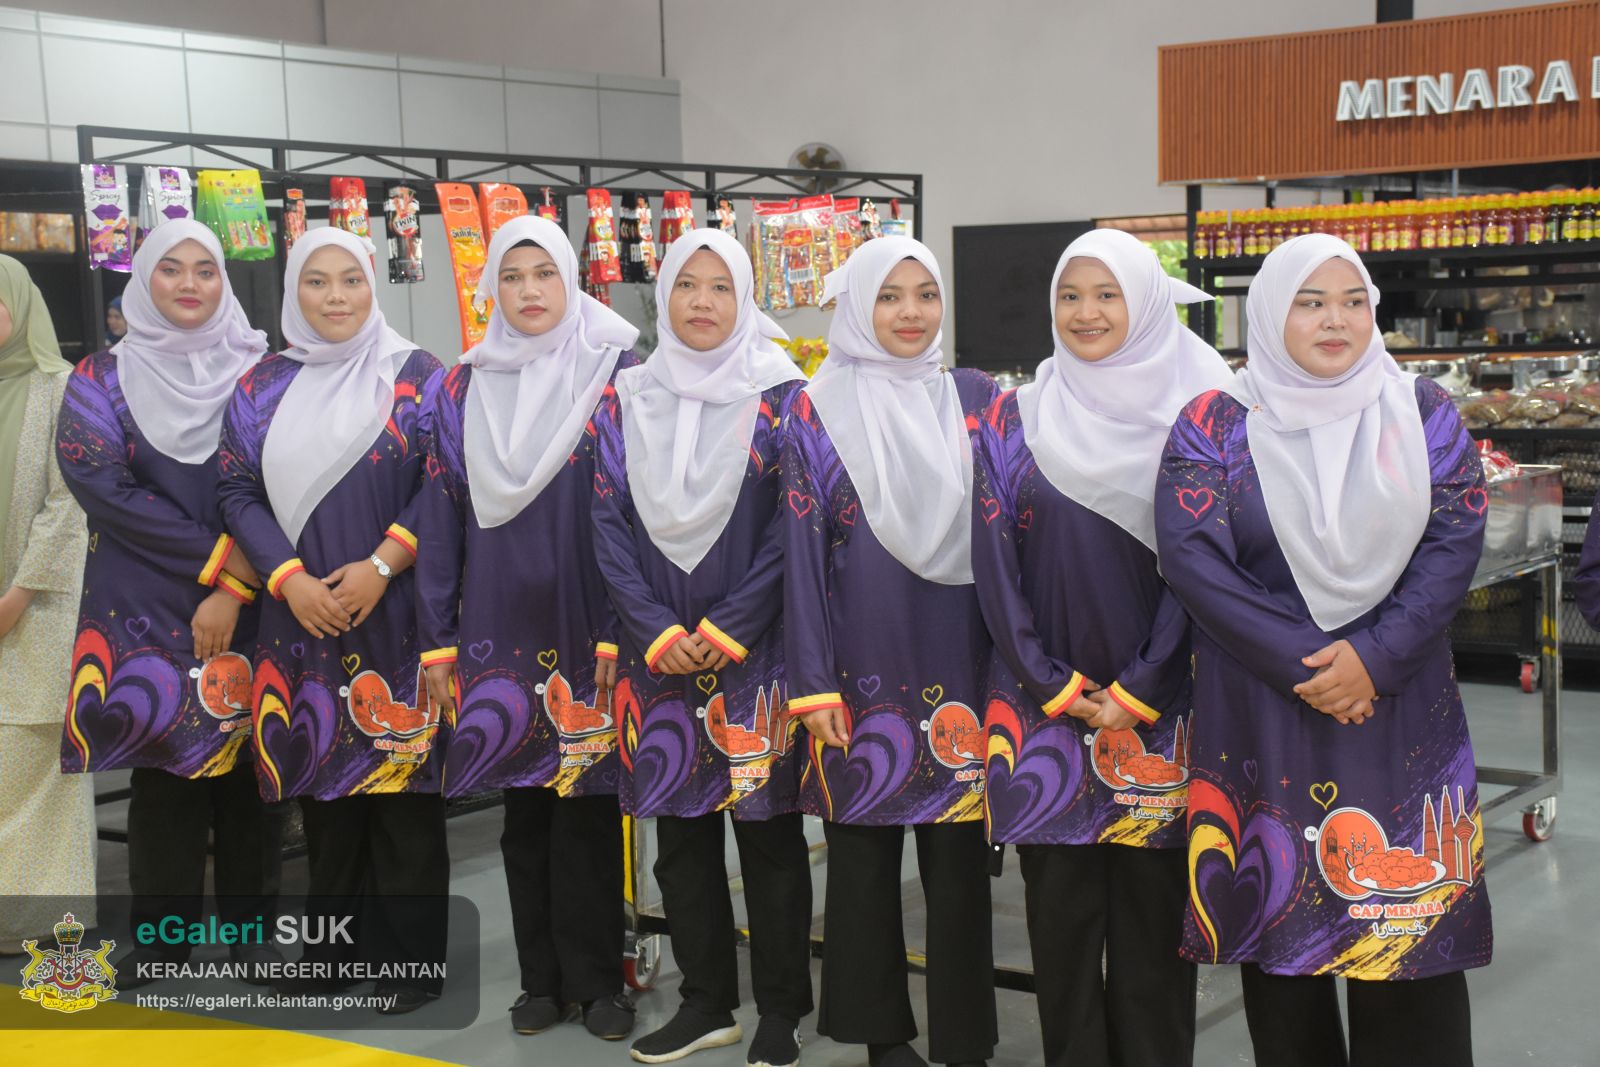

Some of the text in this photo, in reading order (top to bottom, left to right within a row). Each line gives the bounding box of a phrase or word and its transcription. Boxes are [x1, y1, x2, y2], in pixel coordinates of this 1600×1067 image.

[1336, 60, 1579, 121] MENARA
[90, 190, 120, 205] Spicy
[160, 191, 186, 205] Spicy
[395, 215, 416, 228] TWIN
[374, 739, 394, 750] CAP
[566, 743, 611, 754] MENARA
[731, 767, 770, 778] ENARA
[955, 769, 979, 781] CAP
[1114, 793, 1138, 805] CAP
[1348, 901, 1445, 919] CAP MENARA
